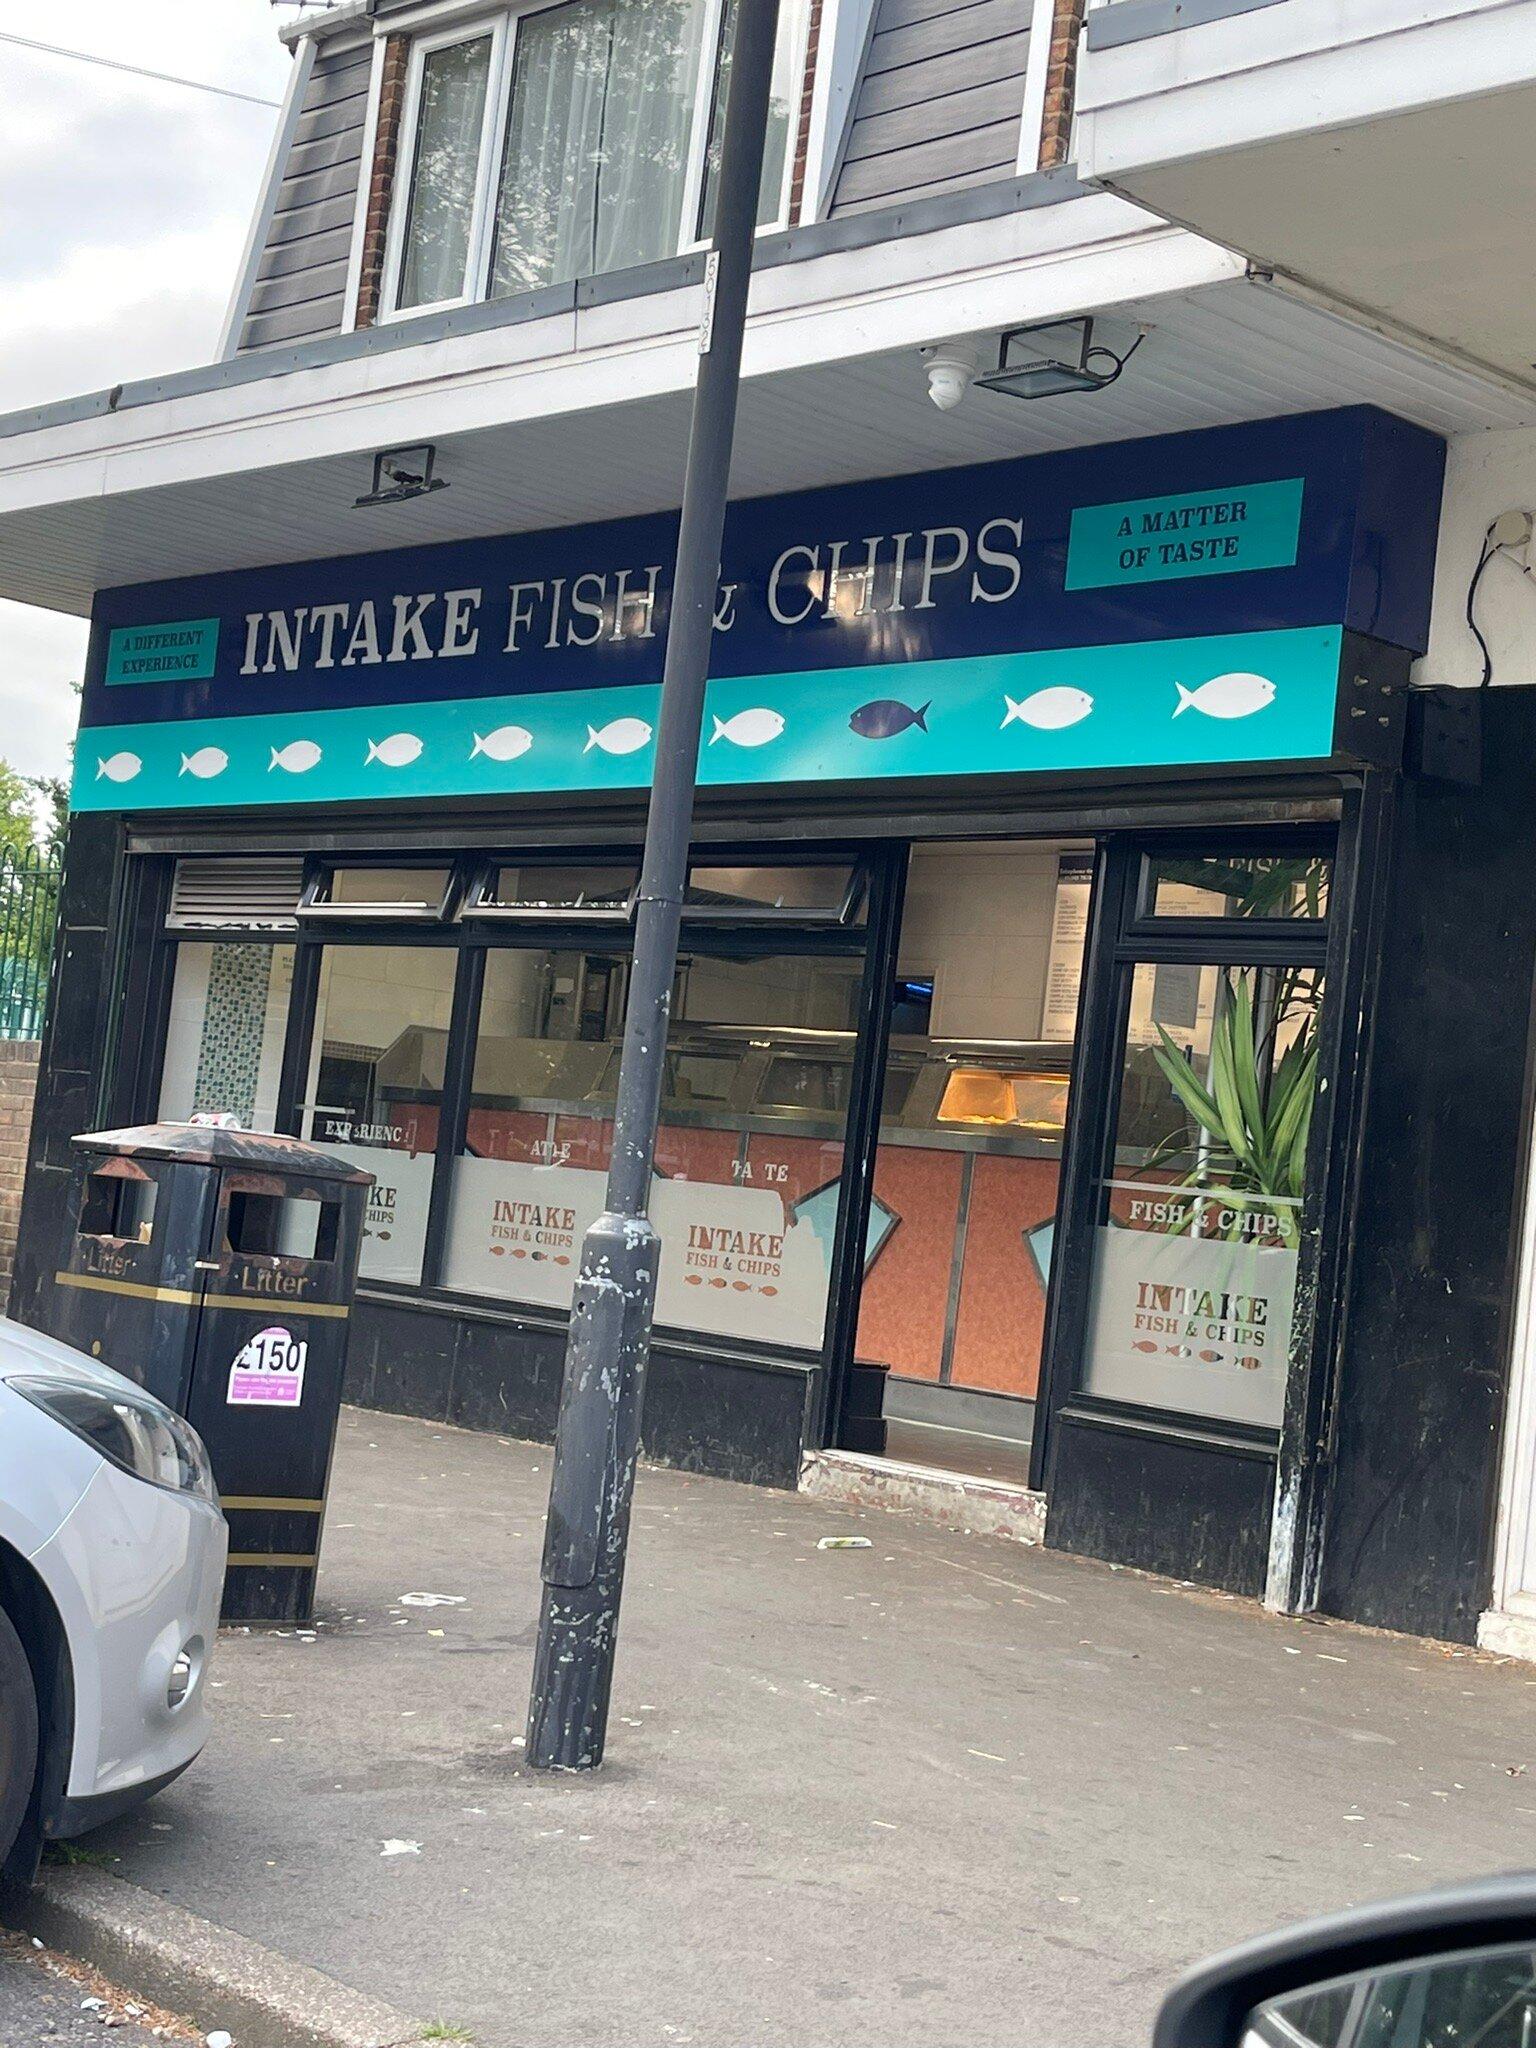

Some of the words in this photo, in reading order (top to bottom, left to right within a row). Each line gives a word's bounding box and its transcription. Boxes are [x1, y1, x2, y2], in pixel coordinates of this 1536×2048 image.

[1117, 516, 1134, 538] A
[1141, 501, 1248, 535] MATTER
[1118, 547, 1146, 570] OF
[1158, 536, 1241, 566] TASTE
[240, 587, 483, 676] INTAKE
[501, 565, 663, 653] FISH
[767, 517, 1024, 626] CHIPS
[122, 638, 131, 651] A
[134, 630, 204, 650] DIFFERENT
[122, 653, 199, 674] EXPERIENCE
[492, 1200, 576, 1231] INTAKE
[1129, 1200, 1186, 1225] FISH
[1193, 1205, 1210, 1229] &
[1218, 1209, 1293, 1237] CHIPS
[490, 1225, 519, 1240] FISH
[522, 1229, 532, 1242] &
[535, 1230, 574, 1248] CHIPS
[687, 1225, 784, 1260] INTAKE
[242, 1265, 310, 1295] Litter
[685, 1252, 718, 1268] FISH
[722, 1257, 733, 1271] &
[737, 1259, 781, 1278] CHIPS
[1136, 1281, 1269, 1326] INTAKE
[1133, 1313, 1179, 1334] FISH
[1185, 1321, 1198, 1338] &
[1205, 1324, 1265, 1348] CHIPS
